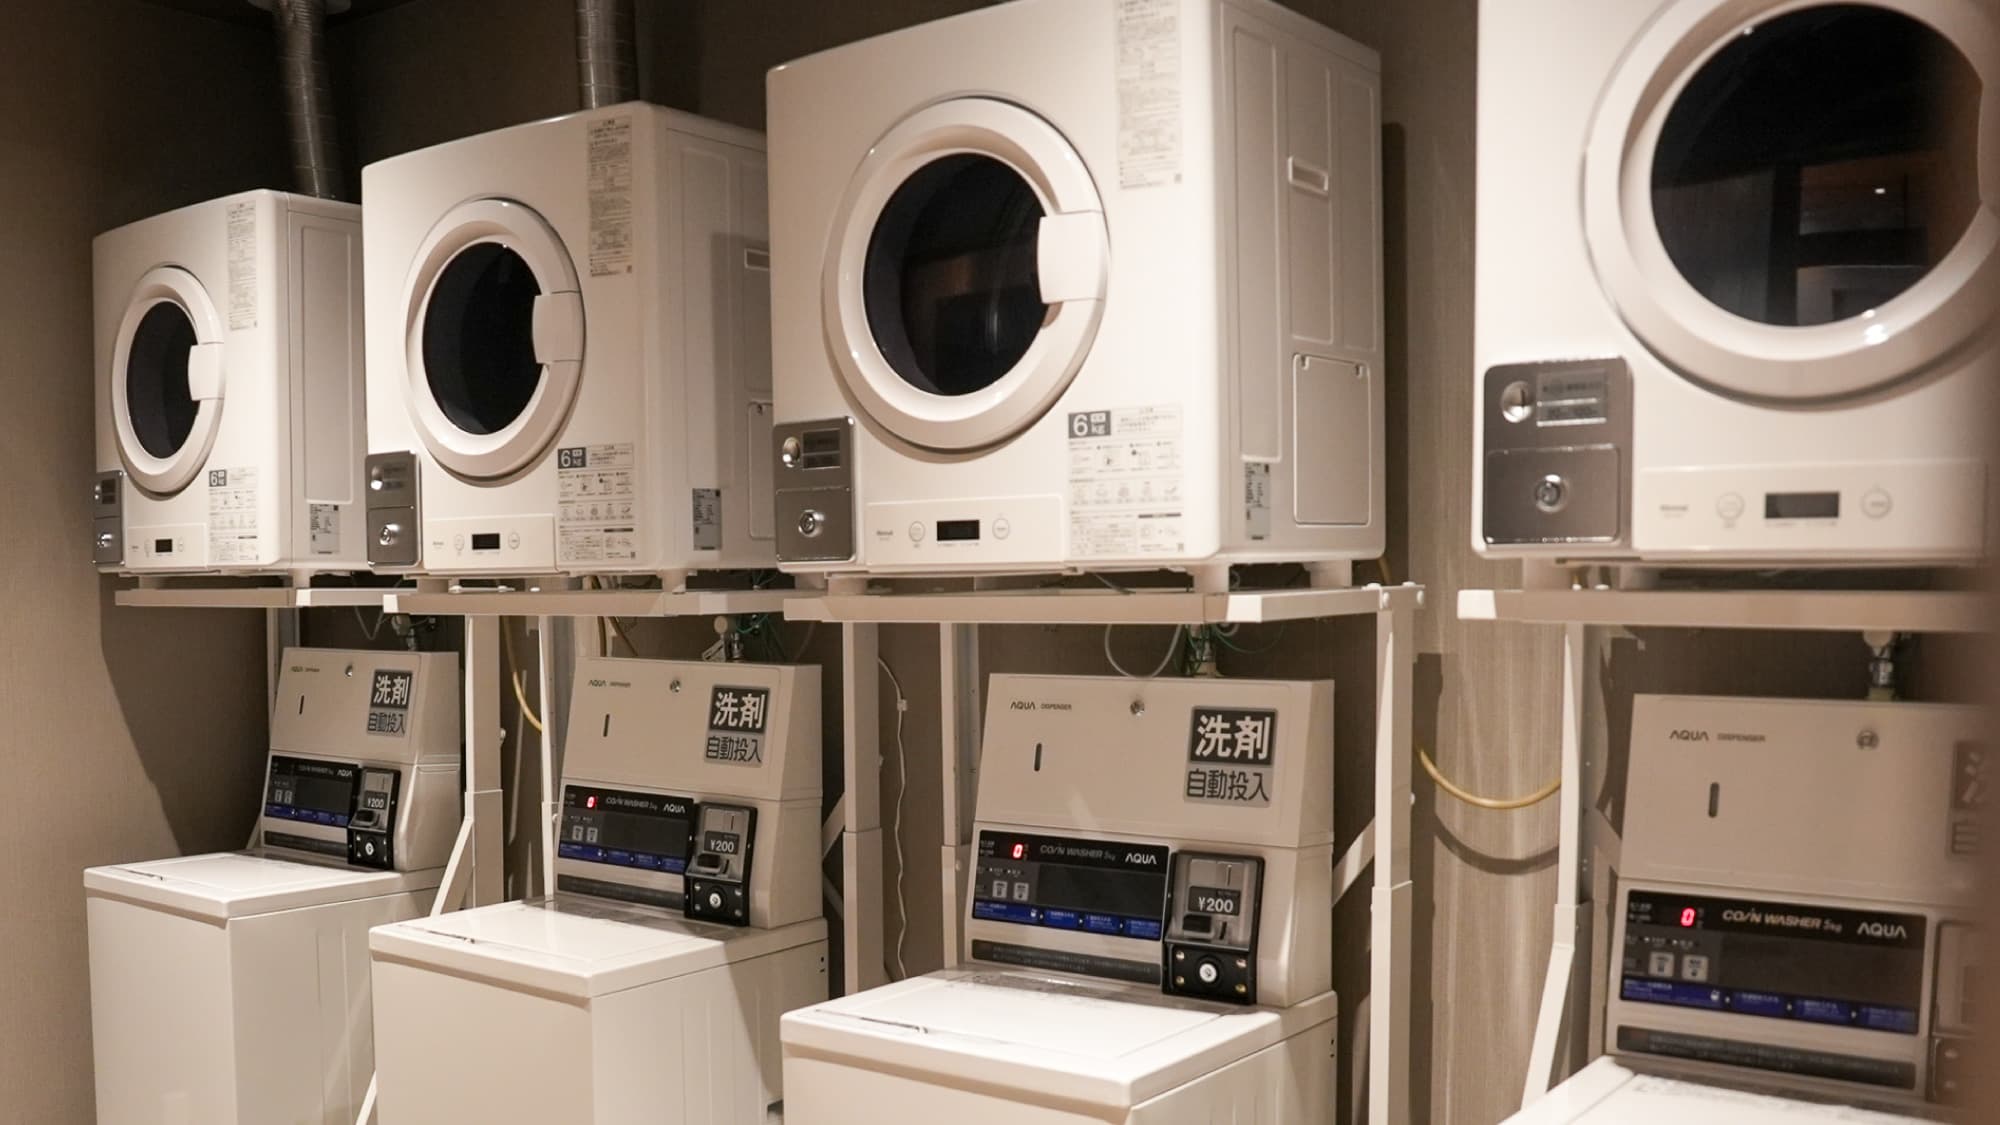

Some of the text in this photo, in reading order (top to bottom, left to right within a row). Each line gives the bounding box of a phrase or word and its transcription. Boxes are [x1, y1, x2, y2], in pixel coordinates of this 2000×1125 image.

[1073, 413, 1088, 437] 6
[560, 449, 571, 468] 6
[210, 471, 218, 486] 6
[373, 674, 410, 705] 洗剤
[588, 679, 607, 688] AQUA
[713, 692, 766, 729] 洗剤
[1010, 701, 1036, 711] AQUA
[367, 712, 406, 734] 自動投入
[1195, 714, 1271, 760] 洗剤
[1669, 729, 1709, 741] AQUA
[706, 736, 762, 763] 自動投入
[1187, 768, 1269, 802] 自動投入
[367, 797, 385, 809] ¥200
[586, 796, 596, 808] 0
[662, 803, 686, 814] AQUA
[710, 839, 735, 853] ¥200
[1013, 844, 1024, 859] 0
[1066, 848, 1103, 859] WASHER
[1125, 852, 1158, 865] AQUA
[1198, 896, 1234, 913] ¥200
[1680, 907, 1696, 927] 0
[1764, 914, 1821, 929] WASHER
[1857, 922, 1907, 939] AQUA
